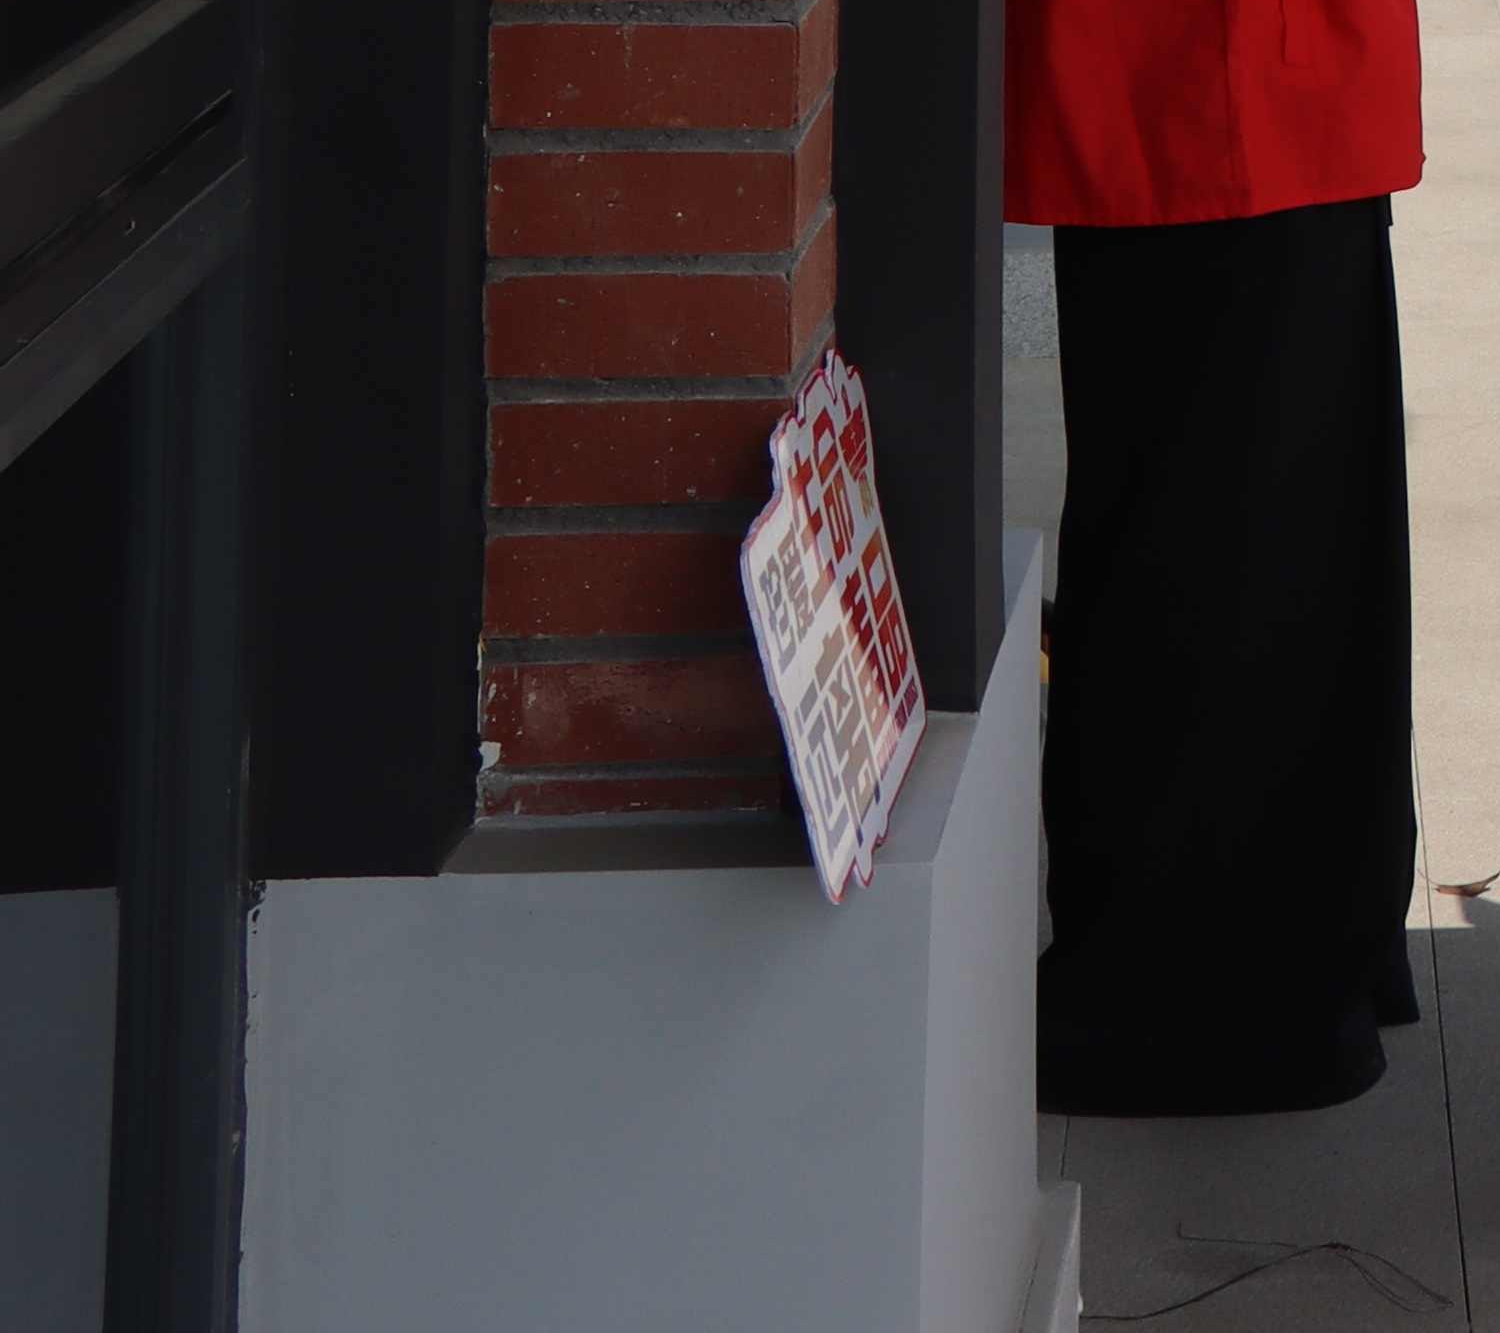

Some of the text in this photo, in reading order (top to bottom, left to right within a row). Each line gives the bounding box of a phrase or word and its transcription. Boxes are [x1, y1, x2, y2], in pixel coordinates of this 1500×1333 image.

[757, 402, 855, 678] 珍爱生命
[792, 525, 909, 862] 远离毒品
